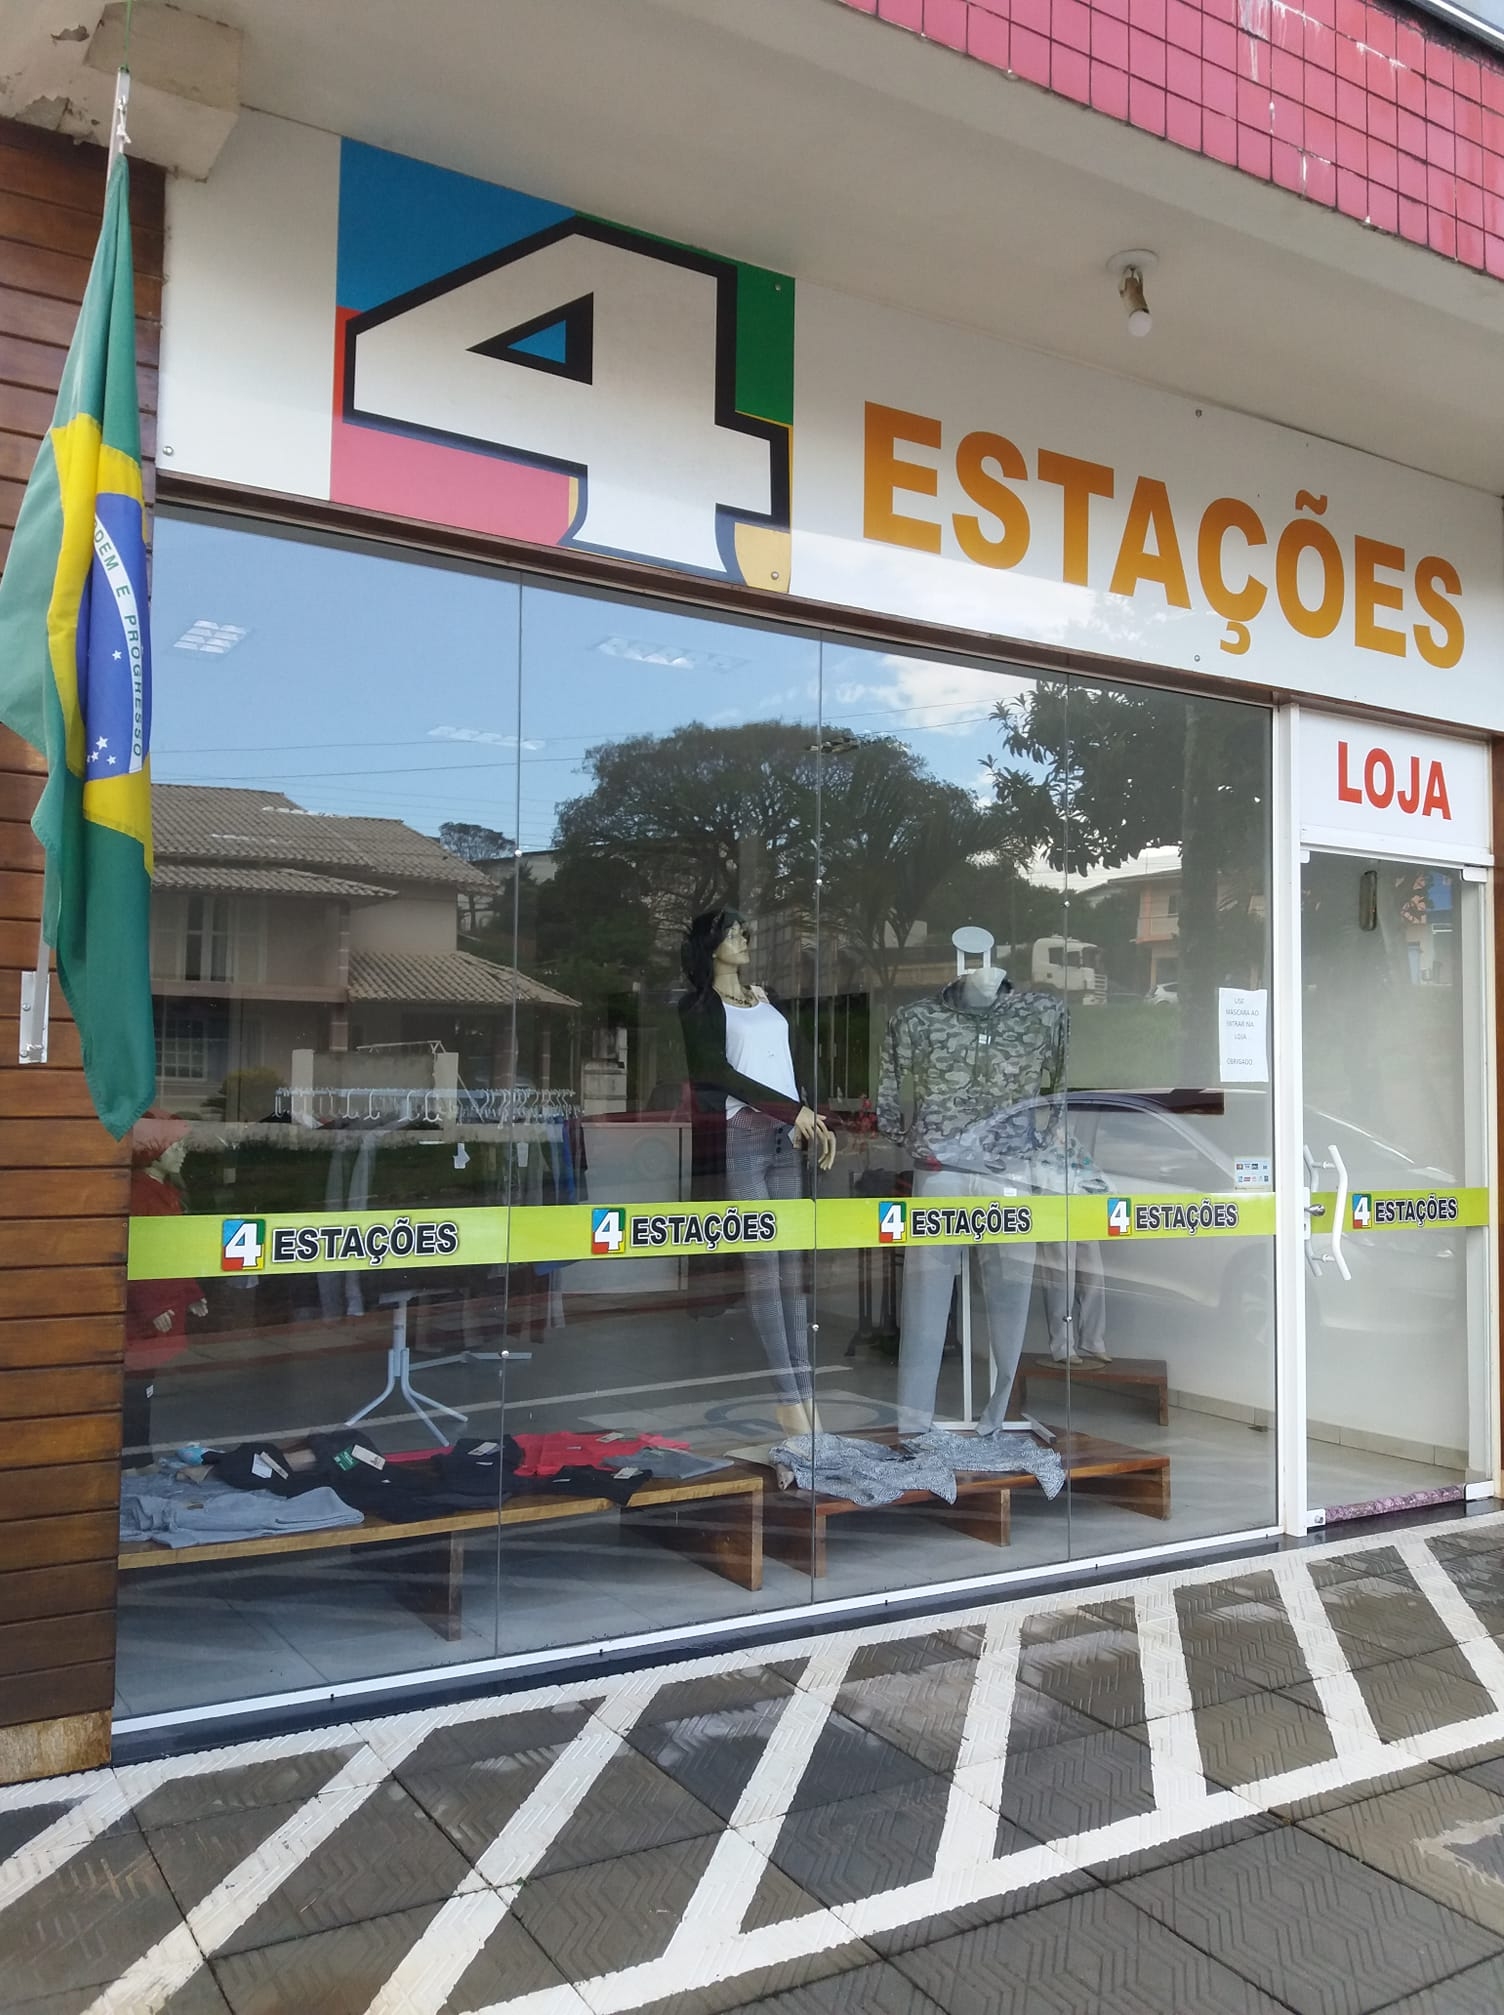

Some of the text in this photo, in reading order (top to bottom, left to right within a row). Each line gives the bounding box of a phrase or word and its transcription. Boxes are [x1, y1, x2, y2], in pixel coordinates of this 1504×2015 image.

[342, 212, 1465, 669] 4 ESTAÇÕES
[116, 585, 131, 598] E
[124, 614, 142, 757] PROGRESSO
[1337, 740, 1452, 820] LOJA
[594, 1207, 776, 1250] 4 ESTAÇÕES
[880, 1203, 1032, 1241] 4 ESTAÇÕES
[1109, 1199, 1239, 1234] 4 ESTAÇÕES
[1354, 1194, 1458, 1227] 4 ESTAÇÕES
[225, 1217, 459, 1268] 4 ESTAÇÕES
